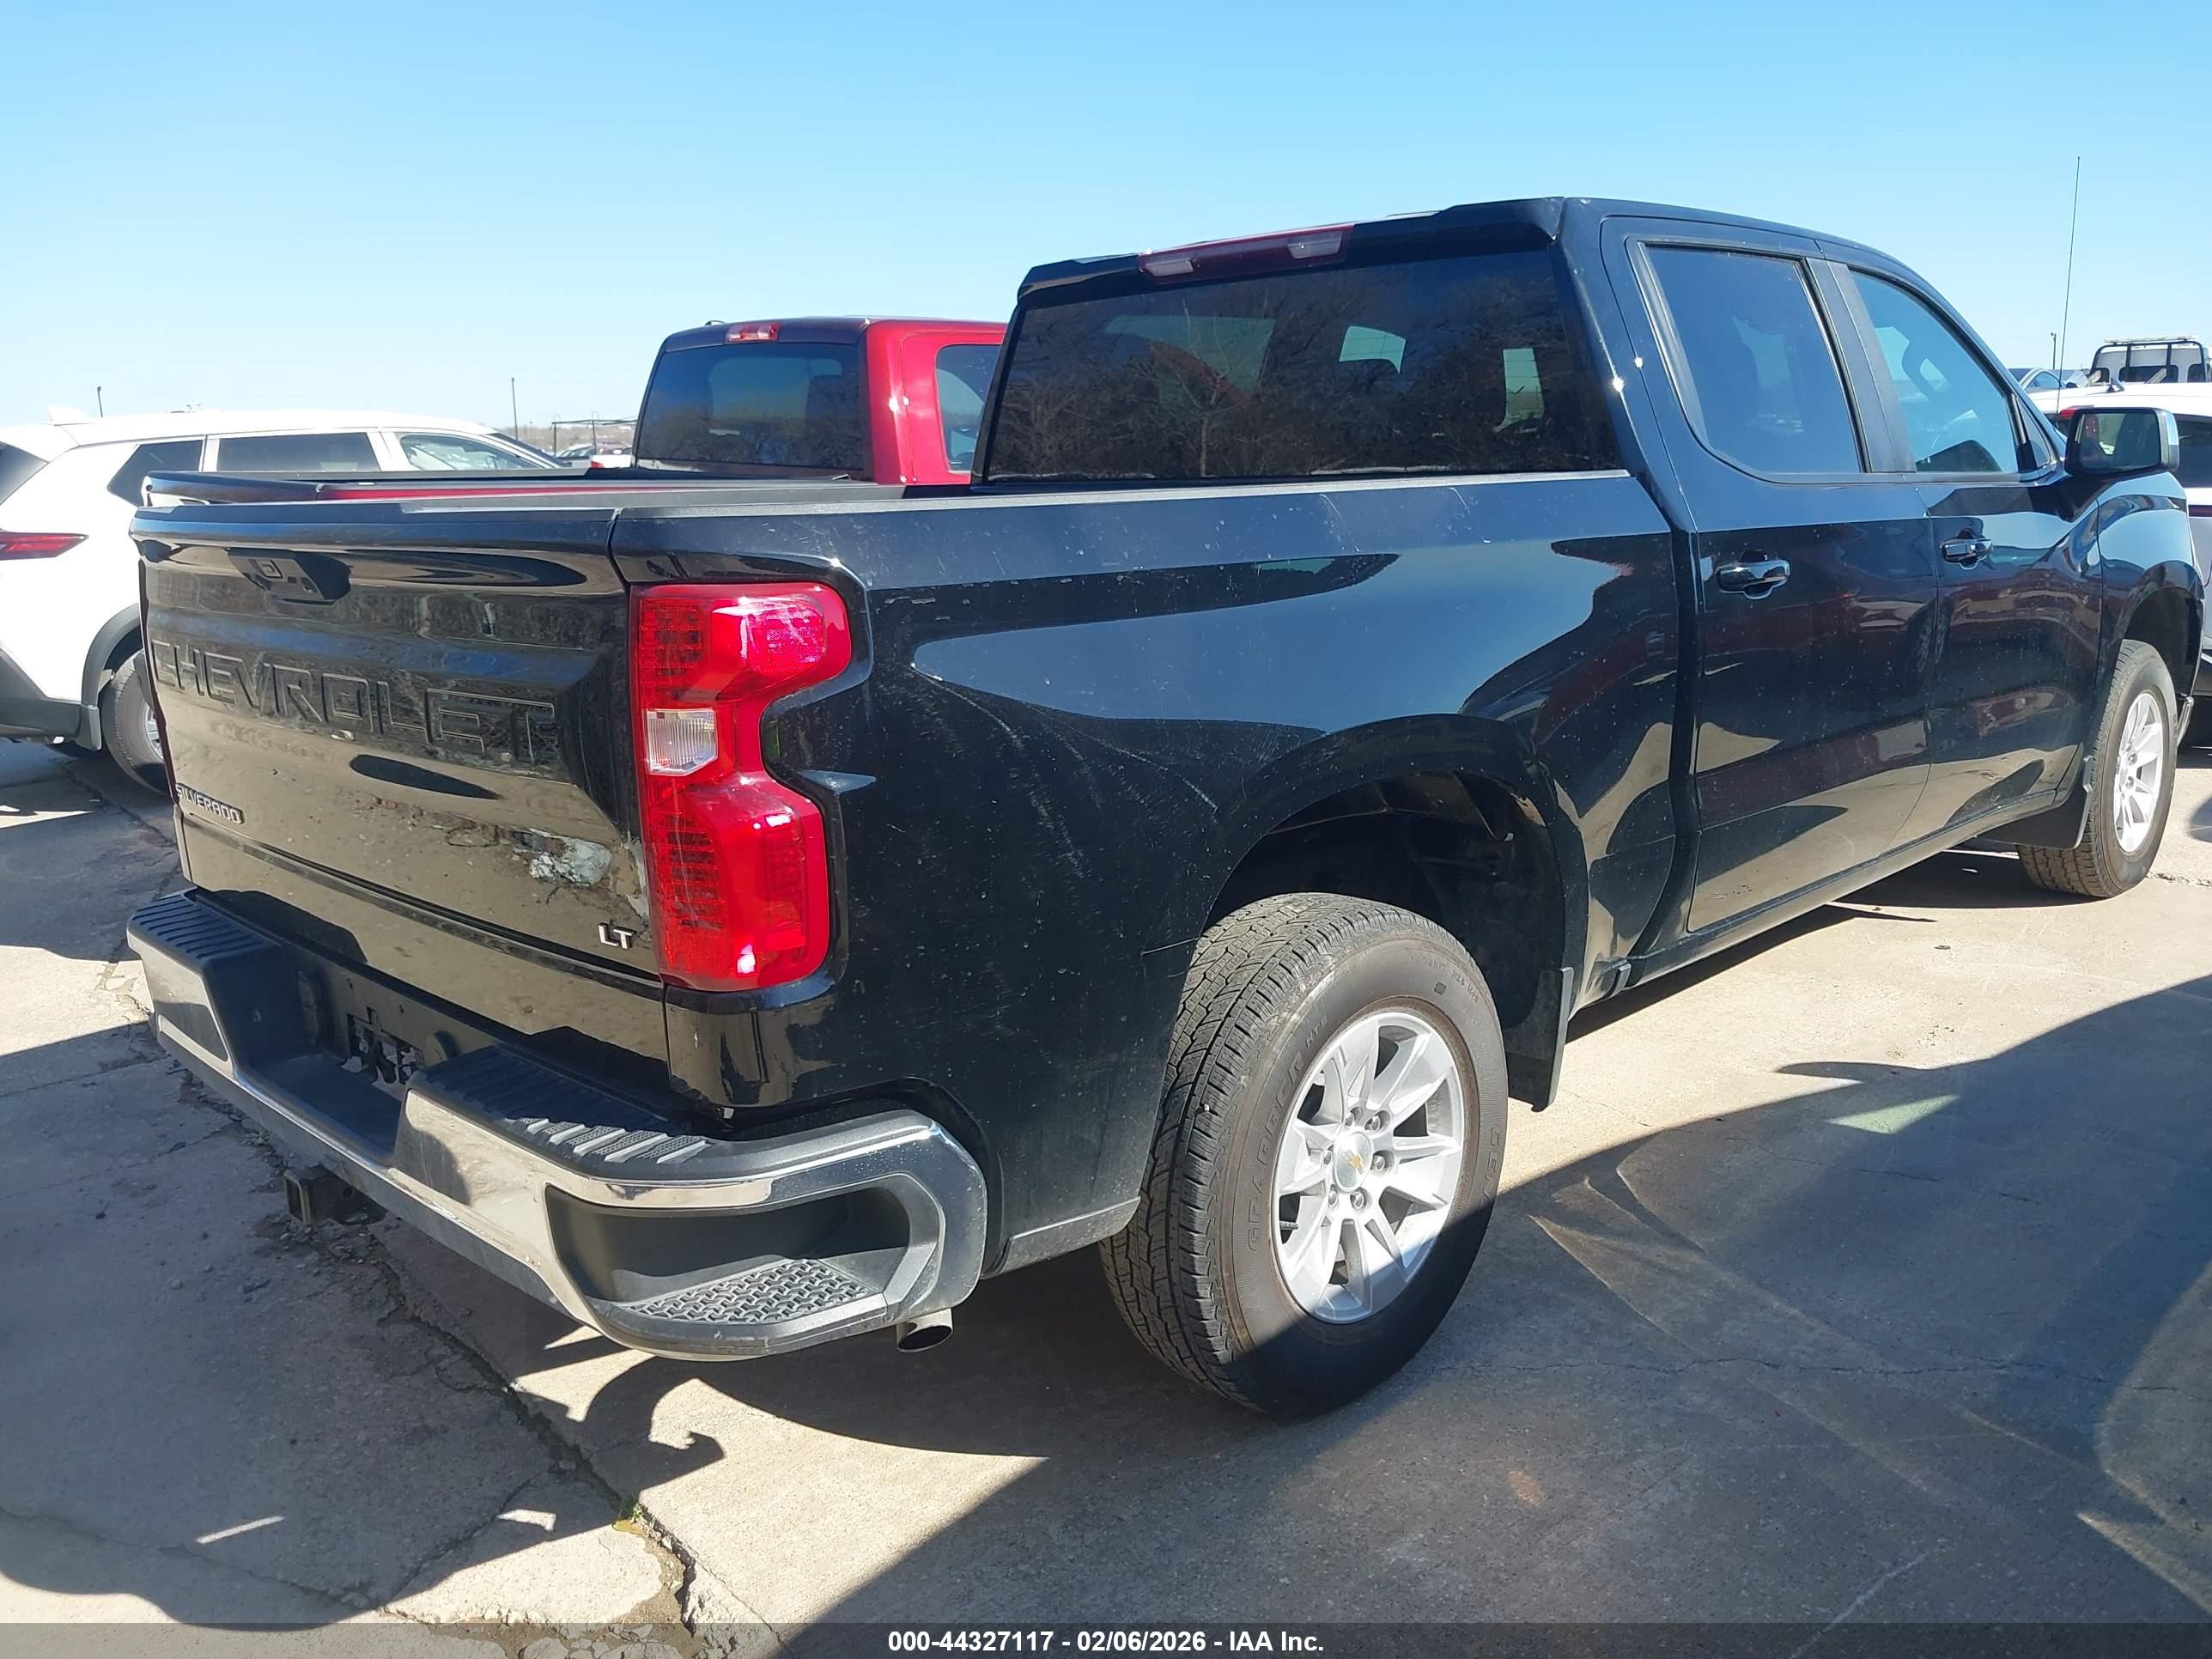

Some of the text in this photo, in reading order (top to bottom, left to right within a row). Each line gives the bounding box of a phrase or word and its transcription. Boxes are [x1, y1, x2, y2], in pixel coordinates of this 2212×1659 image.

[150, 638, 556, 763] CHEVROLET
[175, 783, 242, 824] SILVERADO
[598, 923, 635, 950] LT
